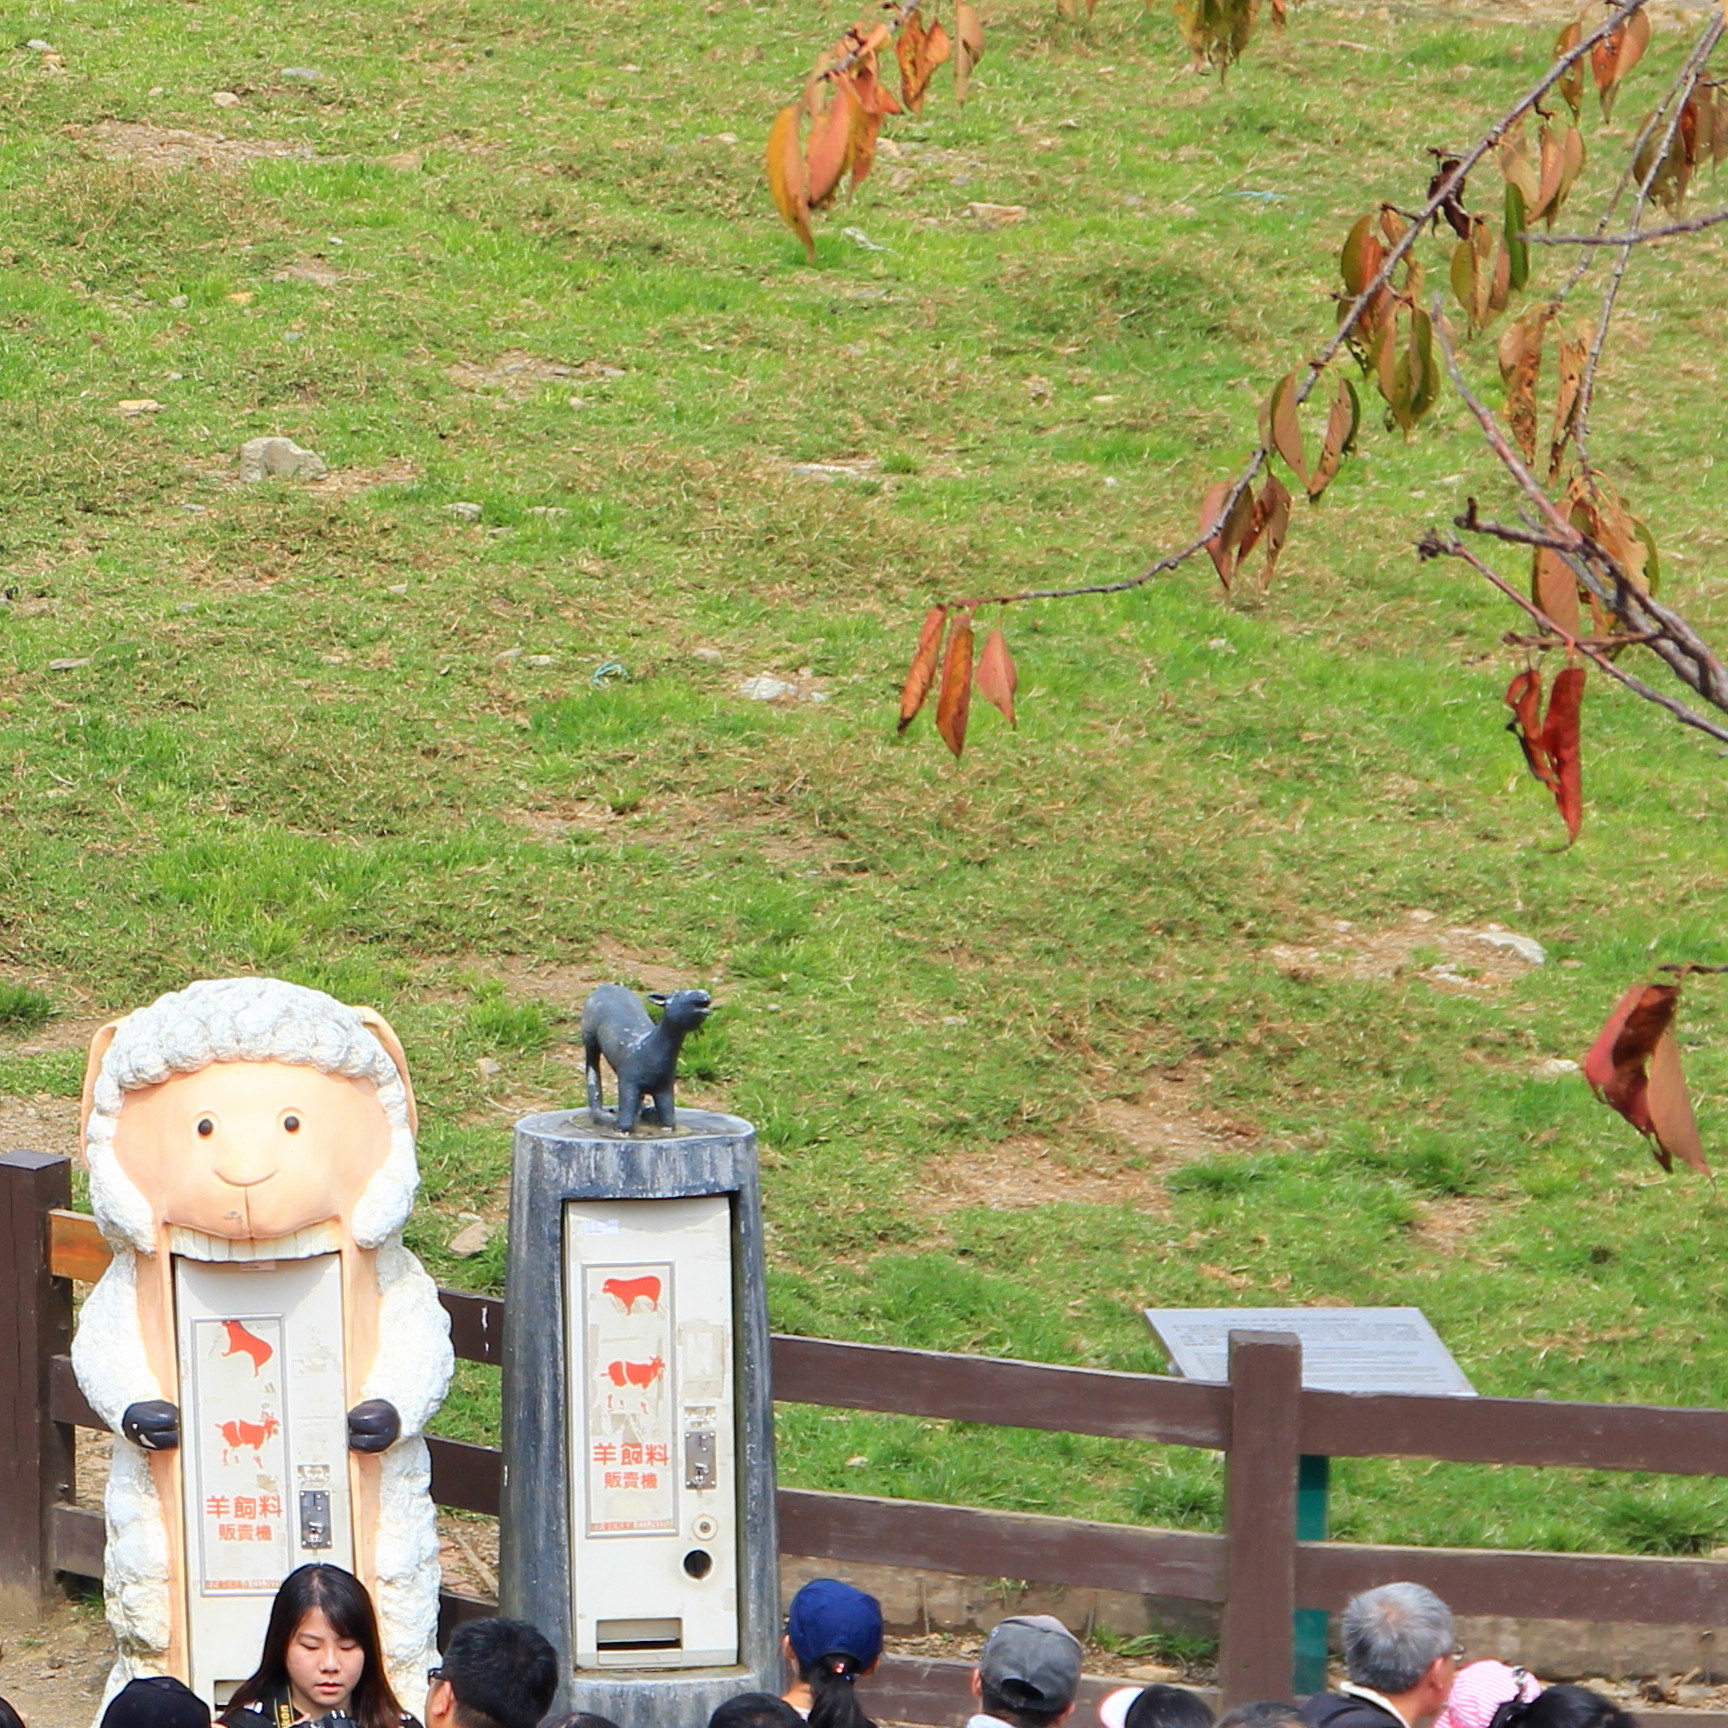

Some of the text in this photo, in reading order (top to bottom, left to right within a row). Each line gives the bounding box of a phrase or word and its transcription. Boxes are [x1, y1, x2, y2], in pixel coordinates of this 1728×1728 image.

[593, 1442, 670, 1466] 羊飼料
[604, 1471, 658, 1489] 販賣機
[206, 1495, 283, 1520] 羊飼料
[218, 1524, 272, 1541] 販賣機
